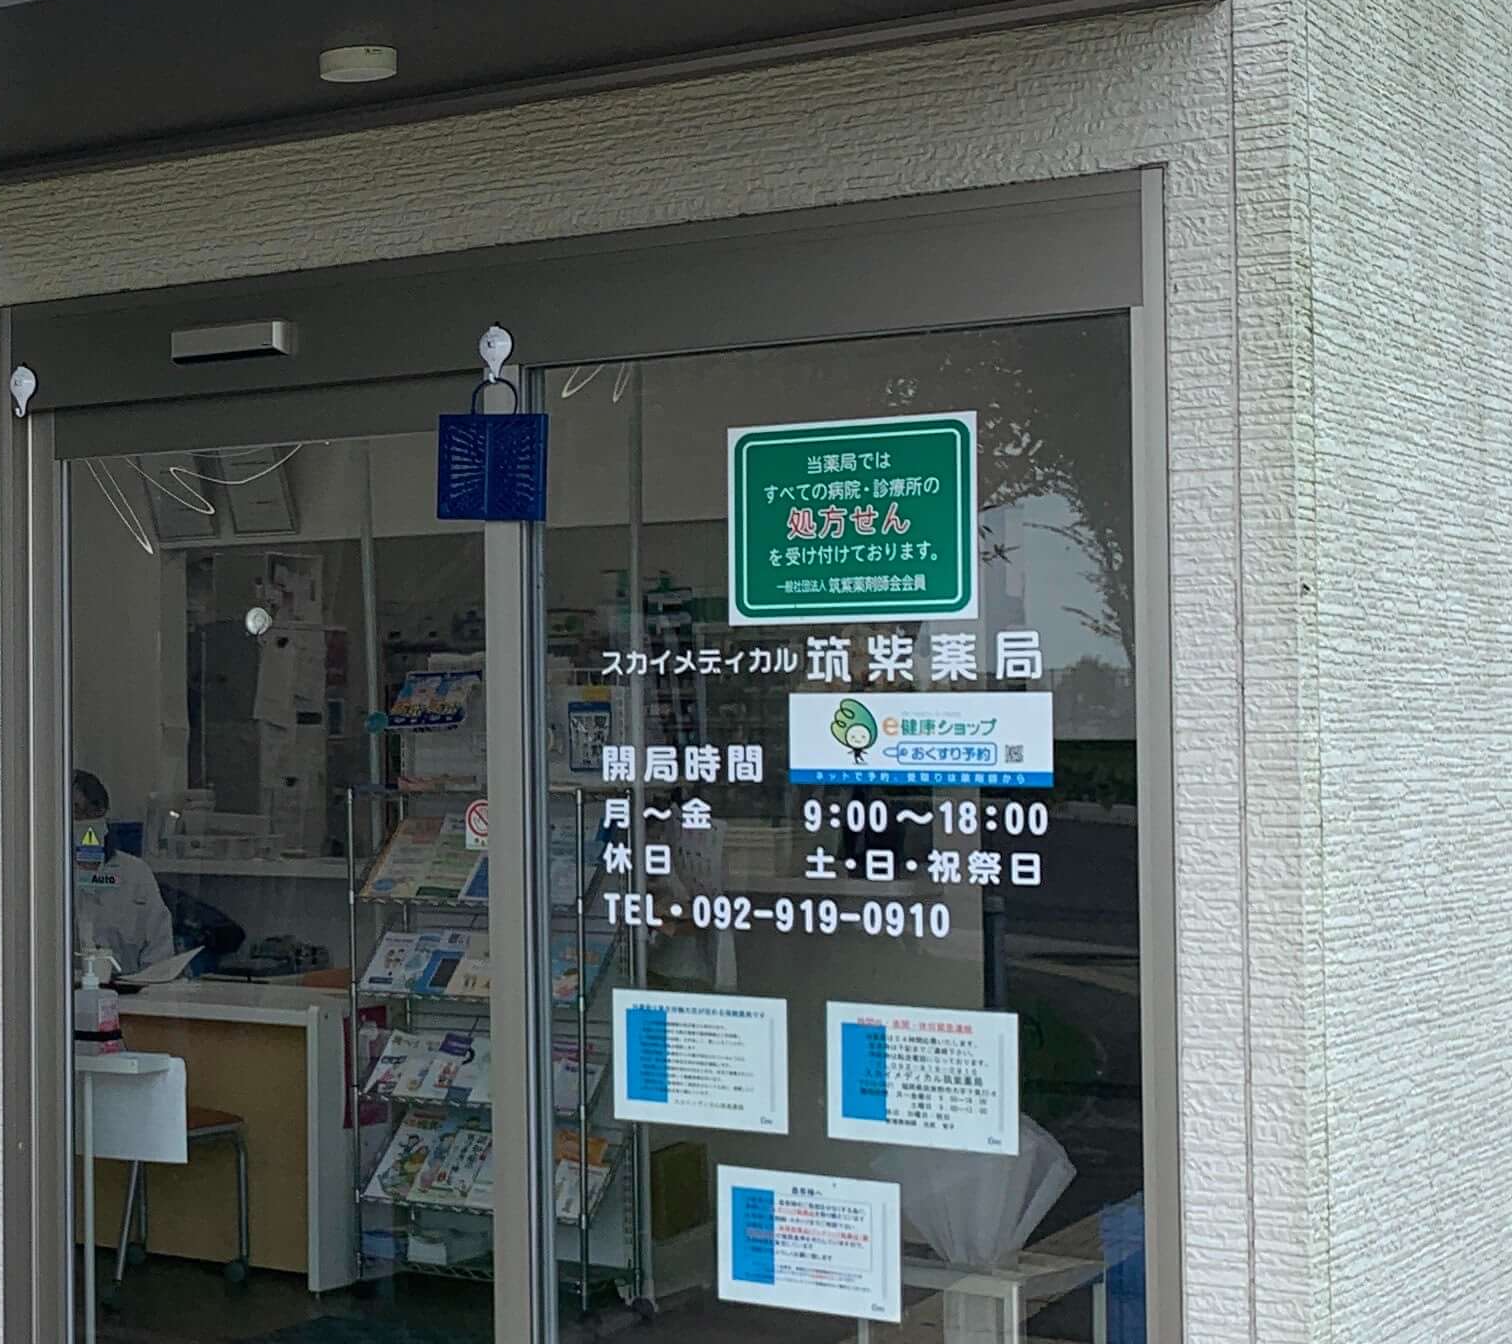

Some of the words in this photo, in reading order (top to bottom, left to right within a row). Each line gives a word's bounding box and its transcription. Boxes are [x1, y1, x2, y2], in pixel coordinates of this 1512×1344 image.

[807, 452, 891, 474] 当薬局では
[764, 477, 939, 504] すべての病院・診療所の
[787, 502, 911, 540] 処方せん
[769, 541, 938, 567] を受け付けております。
[601, 647, 798, 676] スカイメディカル
[806, 630, 1044, 683] 筑紫薬局
[602, 743, 764, 784] 開局時間
[603, 842, 672, 876] 休日
[804, 847, 1042, 887] 土・日・祝祭日
